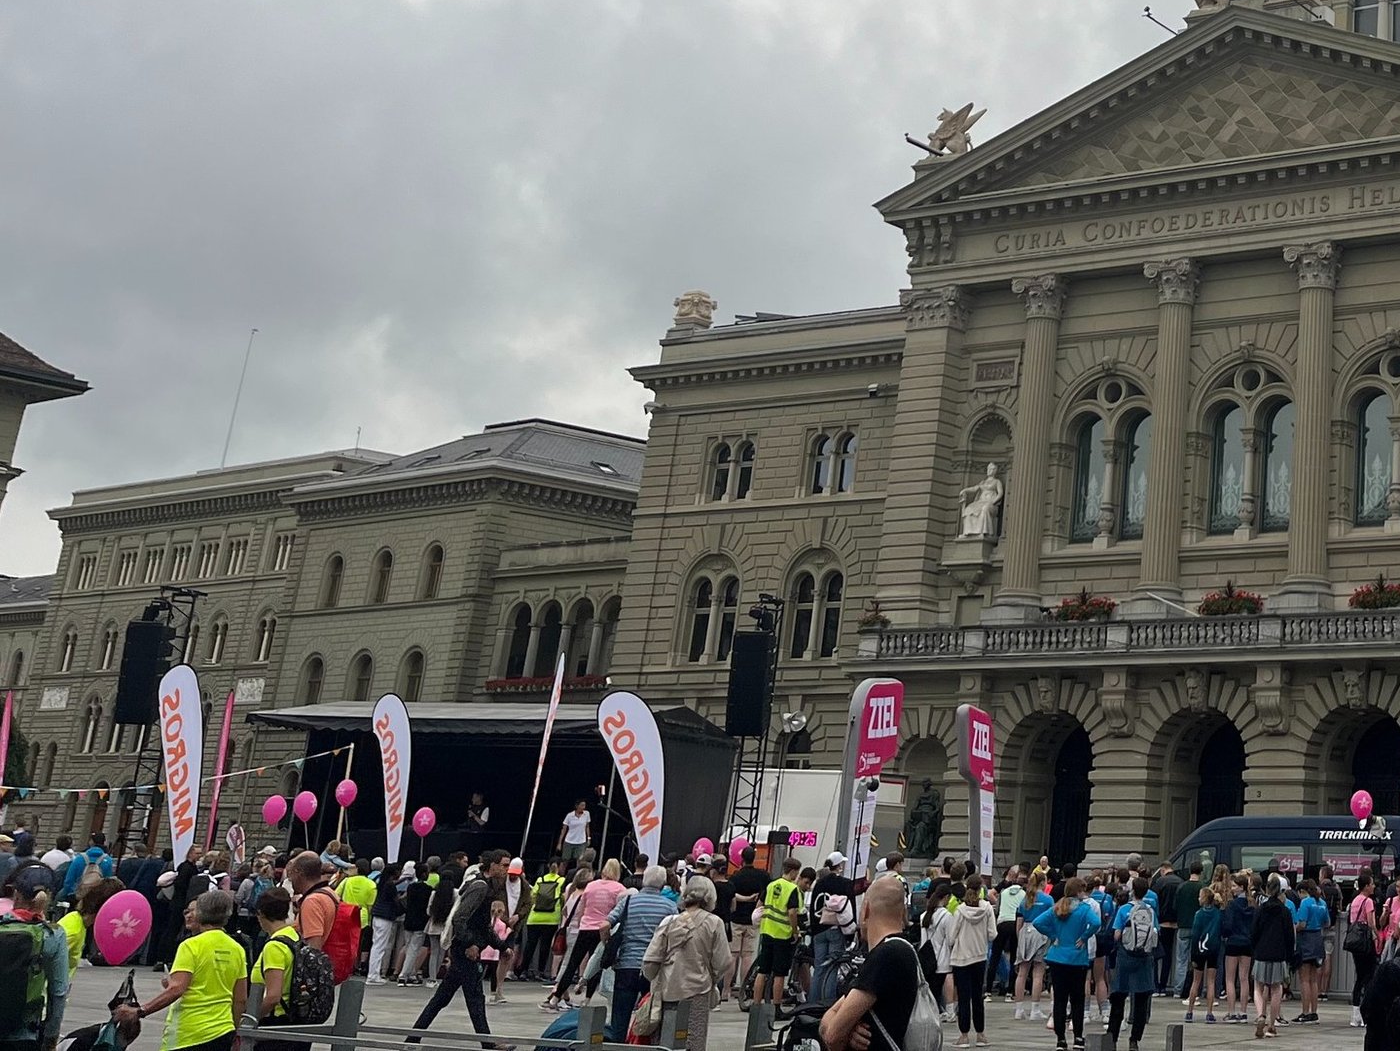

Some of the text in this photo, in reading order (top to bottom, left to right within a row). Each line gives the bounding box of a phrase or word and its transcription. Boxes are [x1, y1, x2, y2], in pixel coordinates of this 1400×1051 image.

[994, 229, 1067, 254] CURIA
[1083, 195, 1331, 243] CONFOEDERATIONIS
[867, 696, 898, 739] ZIEL
[972, 720, 991, 760] ZIEL
[1256, 790, 1262, 798] 3
[789, 832, 816, 846] 49:25
